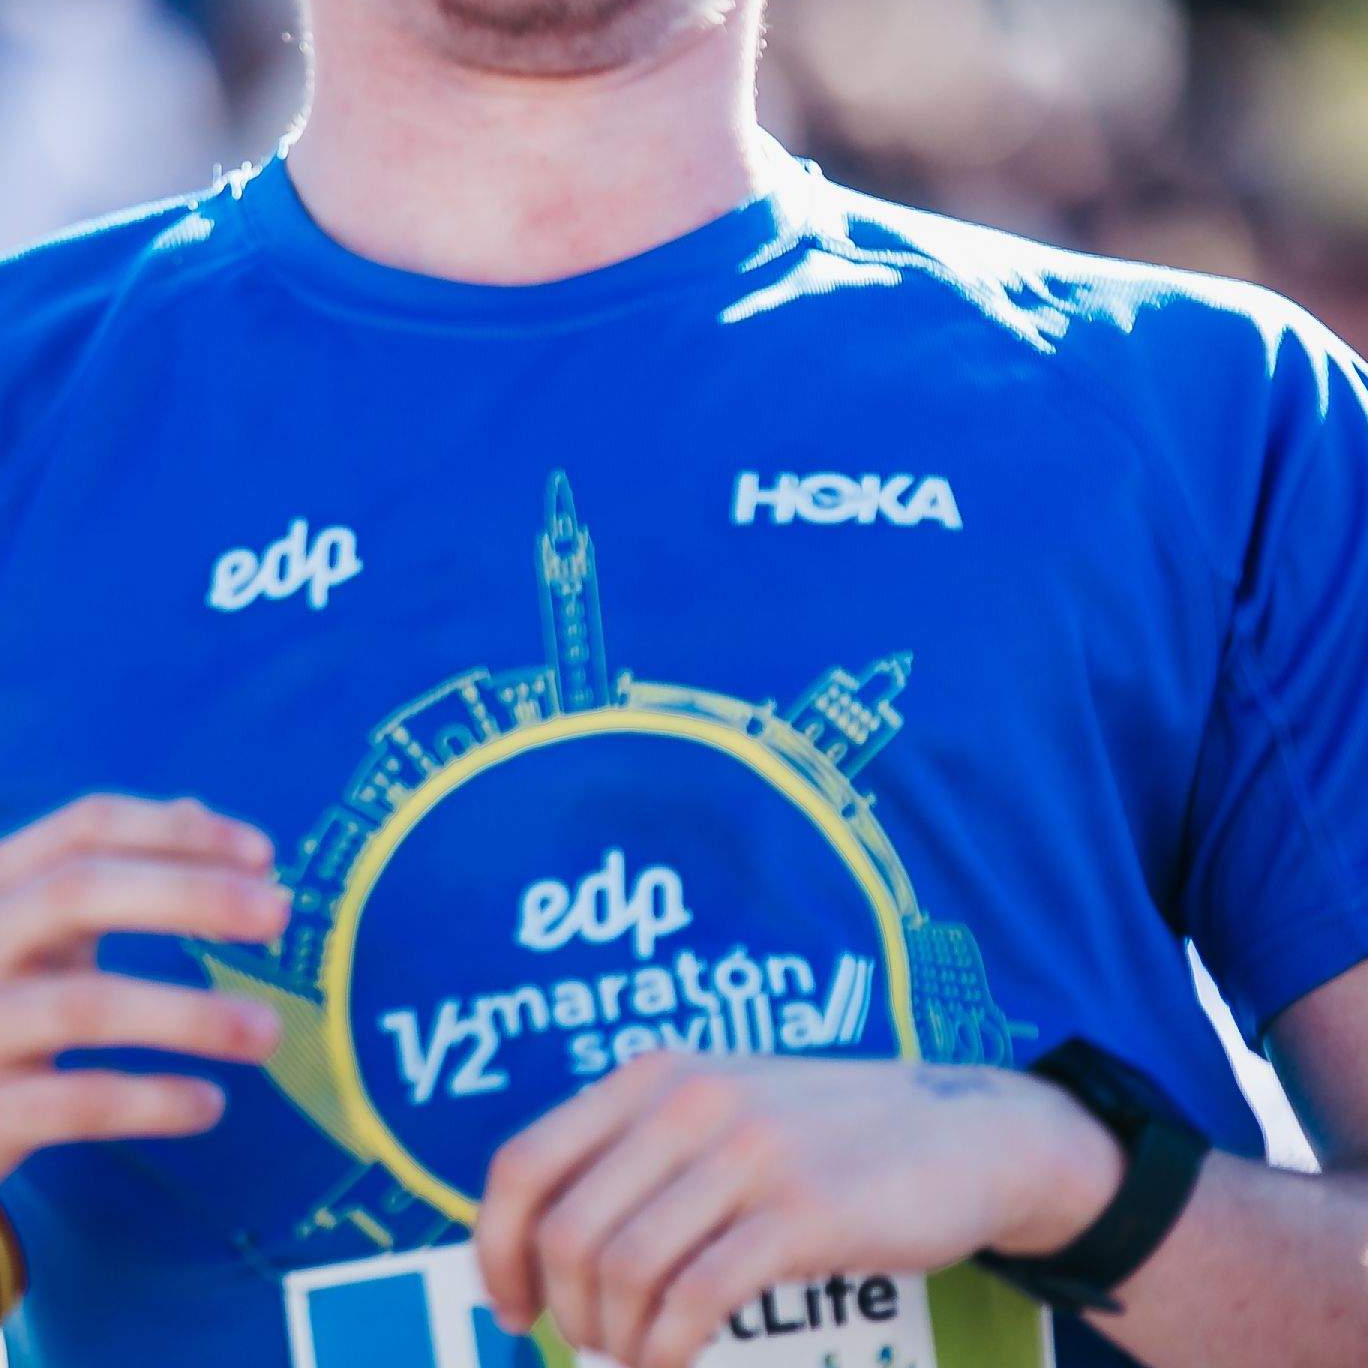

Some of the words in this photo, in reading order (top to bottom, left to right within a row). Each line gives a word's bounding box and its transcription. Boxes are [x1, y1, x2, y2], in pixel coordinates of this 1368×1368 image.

[732, 470, 963, 530] HOKA
[208, 519, 363, 611] edp
[516, 849, 691, 958] edp
[474, 946, 815, 1038] maratón
